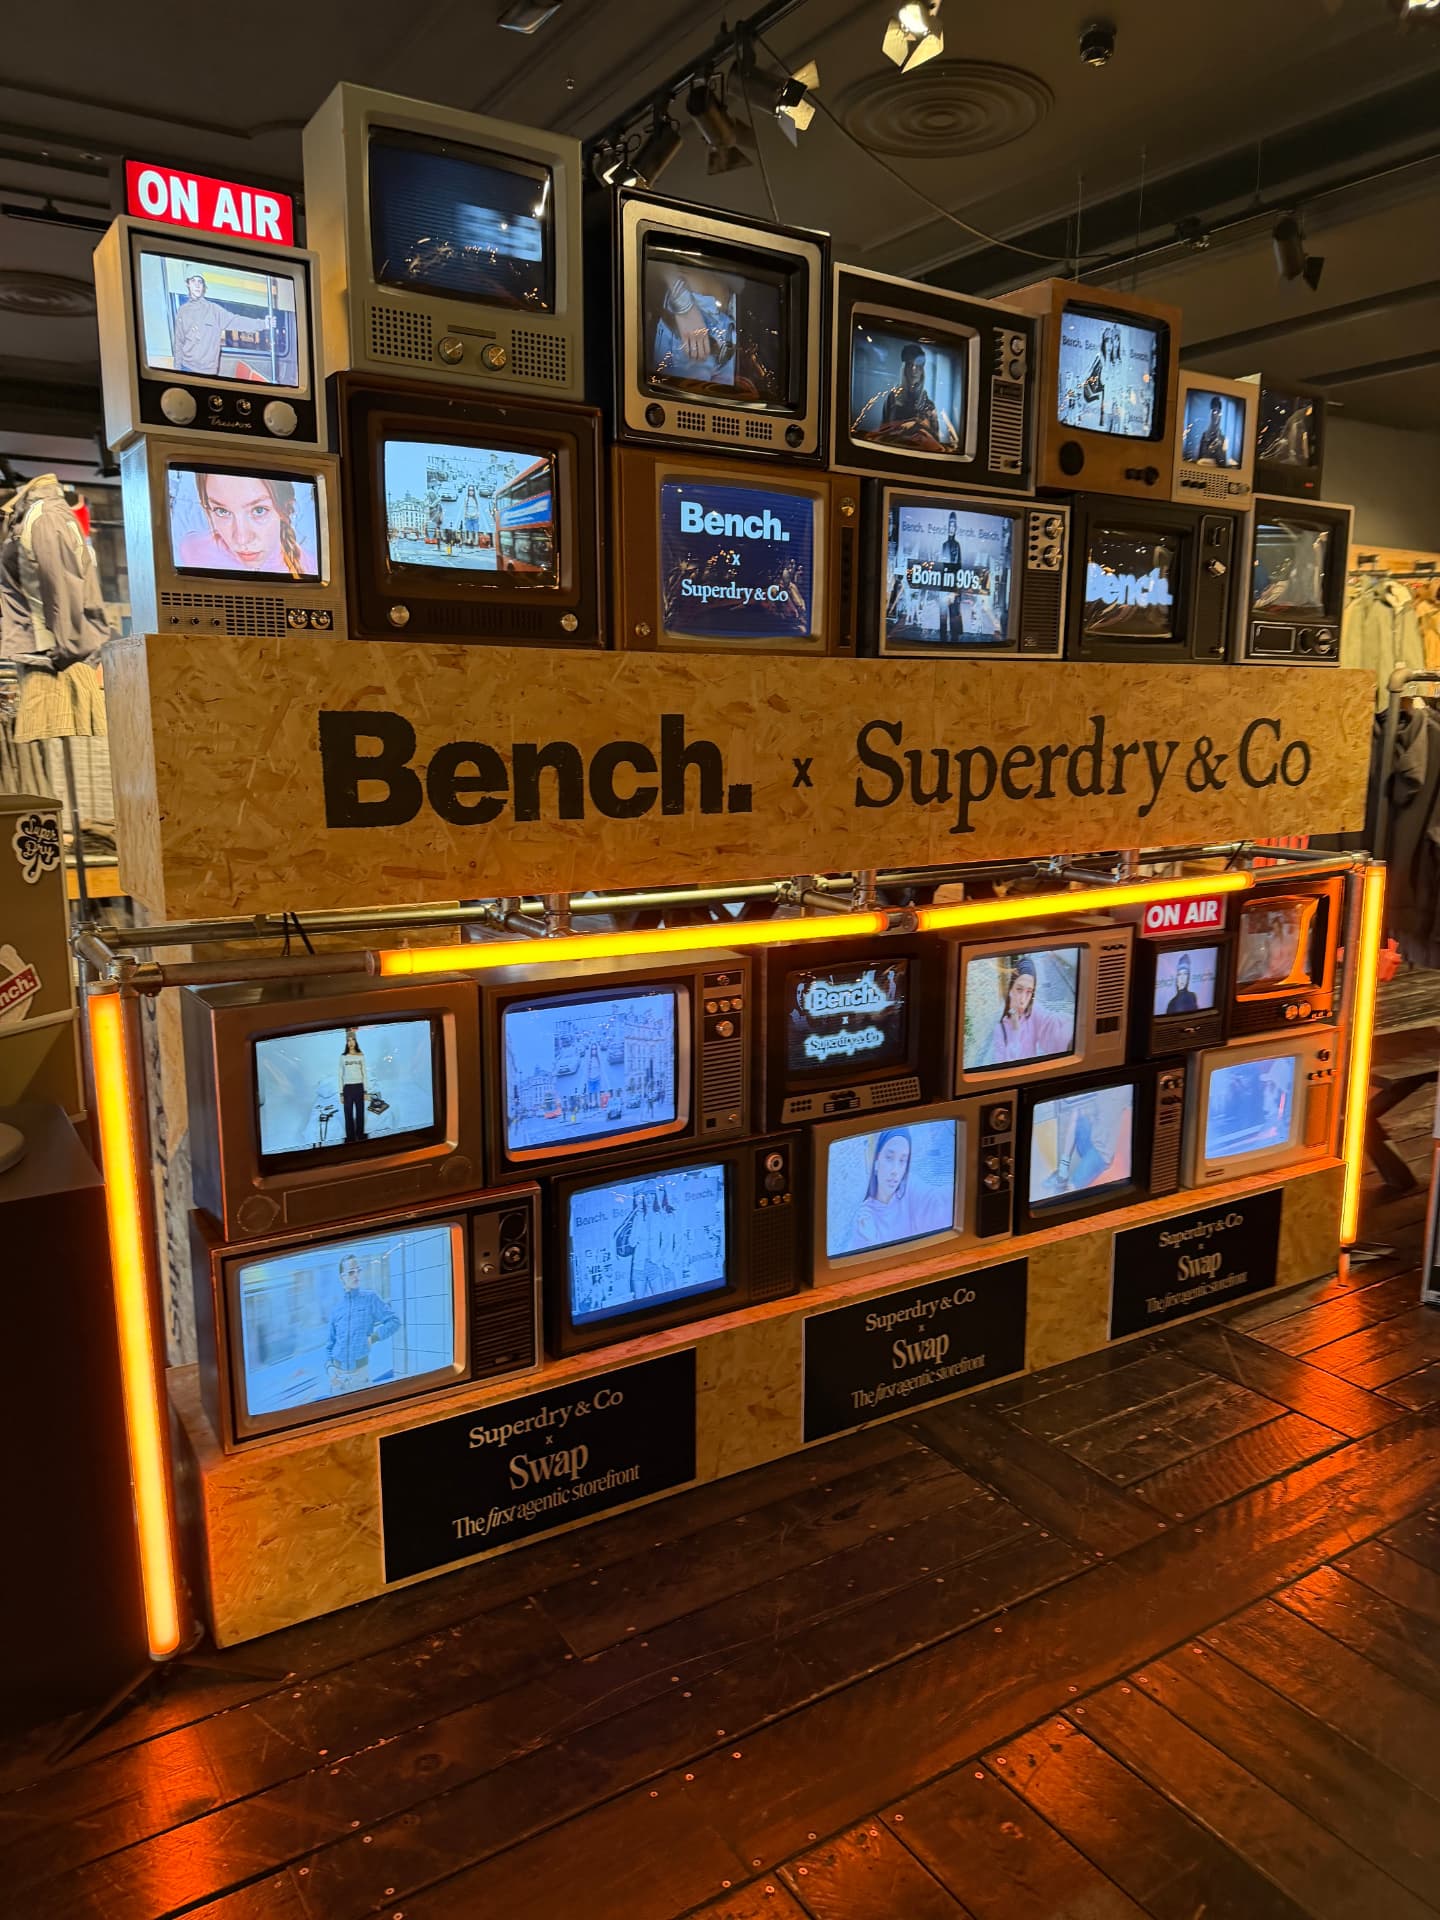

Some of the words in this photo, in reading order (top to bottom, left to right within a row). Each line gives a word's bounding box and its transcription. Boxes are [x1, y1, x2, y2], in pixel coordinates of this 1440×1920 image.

[138, 170, 199, 224] ON
[212, 187, 283, 241] AIR
[681, 501, 790, 541] Bench.
[732, 554, 741, 566] x
[911, 564, 941, 588] Born
[943, 567, 955, 588] in
[956, 568, 982, 590] 90's.
[681, 579, 754, 605] Superdry
[753, 587, 766, 601] &
[767, 584, 789, 602] Co
[318, 710, 753, 829] Bench.
[792, 757, 813, 788] x
[855, 715, 1180, 834] Superdry
[1186, 735, 1227, 793] &
[1239, 718, 1312, 788] Co
[1147, 904, 1181, 929] ON
[1184, 901, 1218, 925] AIR
[0, 976, 36, 1008] nch.
[865, 1299, 940, 1332] Superdry
[940, 1296, 953, 1310] &
[953, 1288, 976, 1305] Co
[892, 1333, 950, 1369] Swap
[851, 1389, 875, 1409] The
[468, 1404, 574, 1449] Superdry
[574, 1400, 592, 1417] &
[593, 1389, 624, 1410] Co
[545, 1434, 554, 1445] x
[509, 1444, 589, 1490] Swap
[451, 1516, 486, 1539] The
[481, 1506, 516, 1536] first
[516, 1486, 571, 1521] agentic
[571, 1464, 641, 1501] storefront
